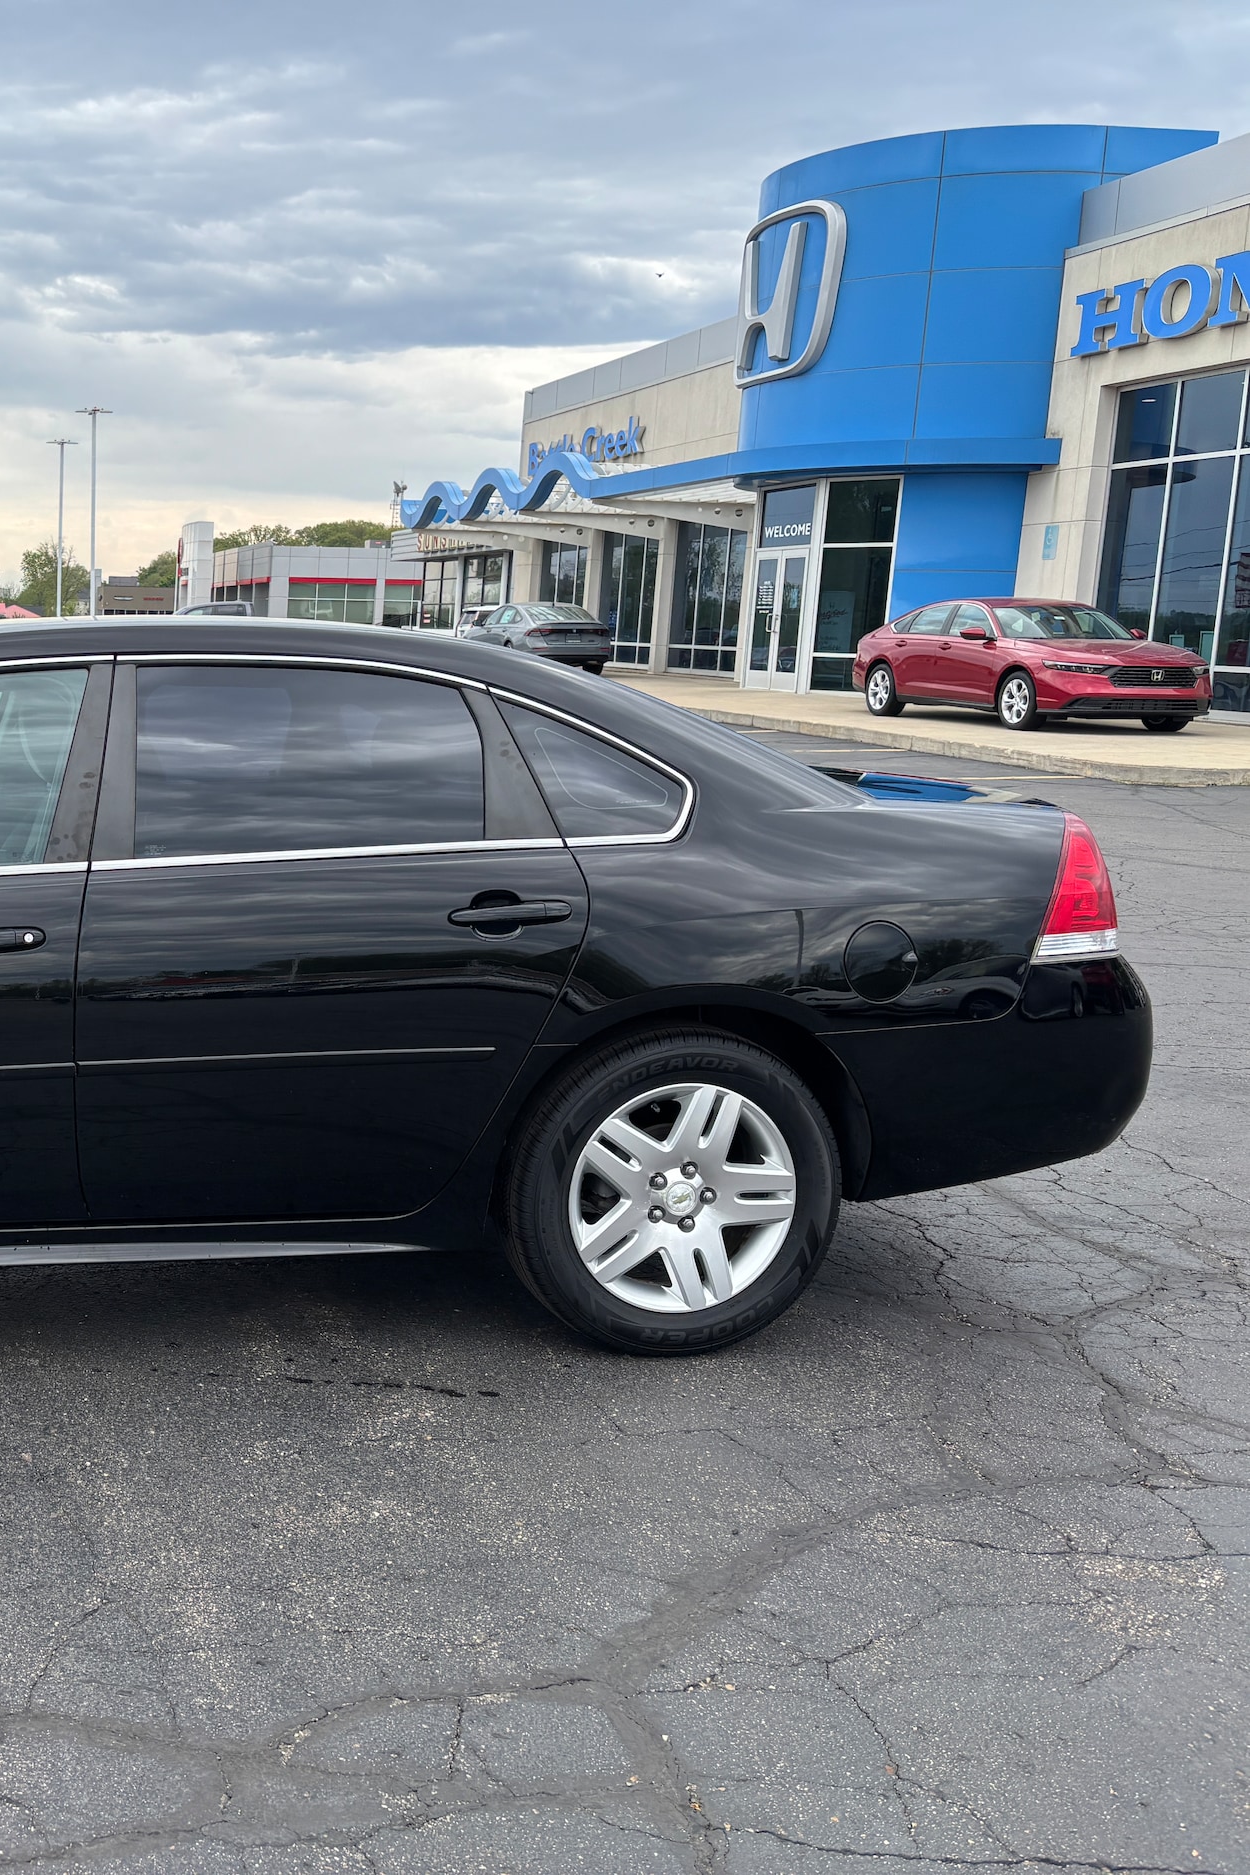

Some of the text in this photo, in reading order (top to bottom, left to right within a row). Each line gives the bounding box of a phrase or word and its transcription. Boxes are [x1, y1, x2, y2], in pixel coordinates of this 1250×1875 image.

[581, 415, 644, 462] Creek
[764, 522, 812, 539] WELCOME
[597, 1055, 740, 1104] ENDEAVOR
[639, 1295, 775, 1346] COOPER
